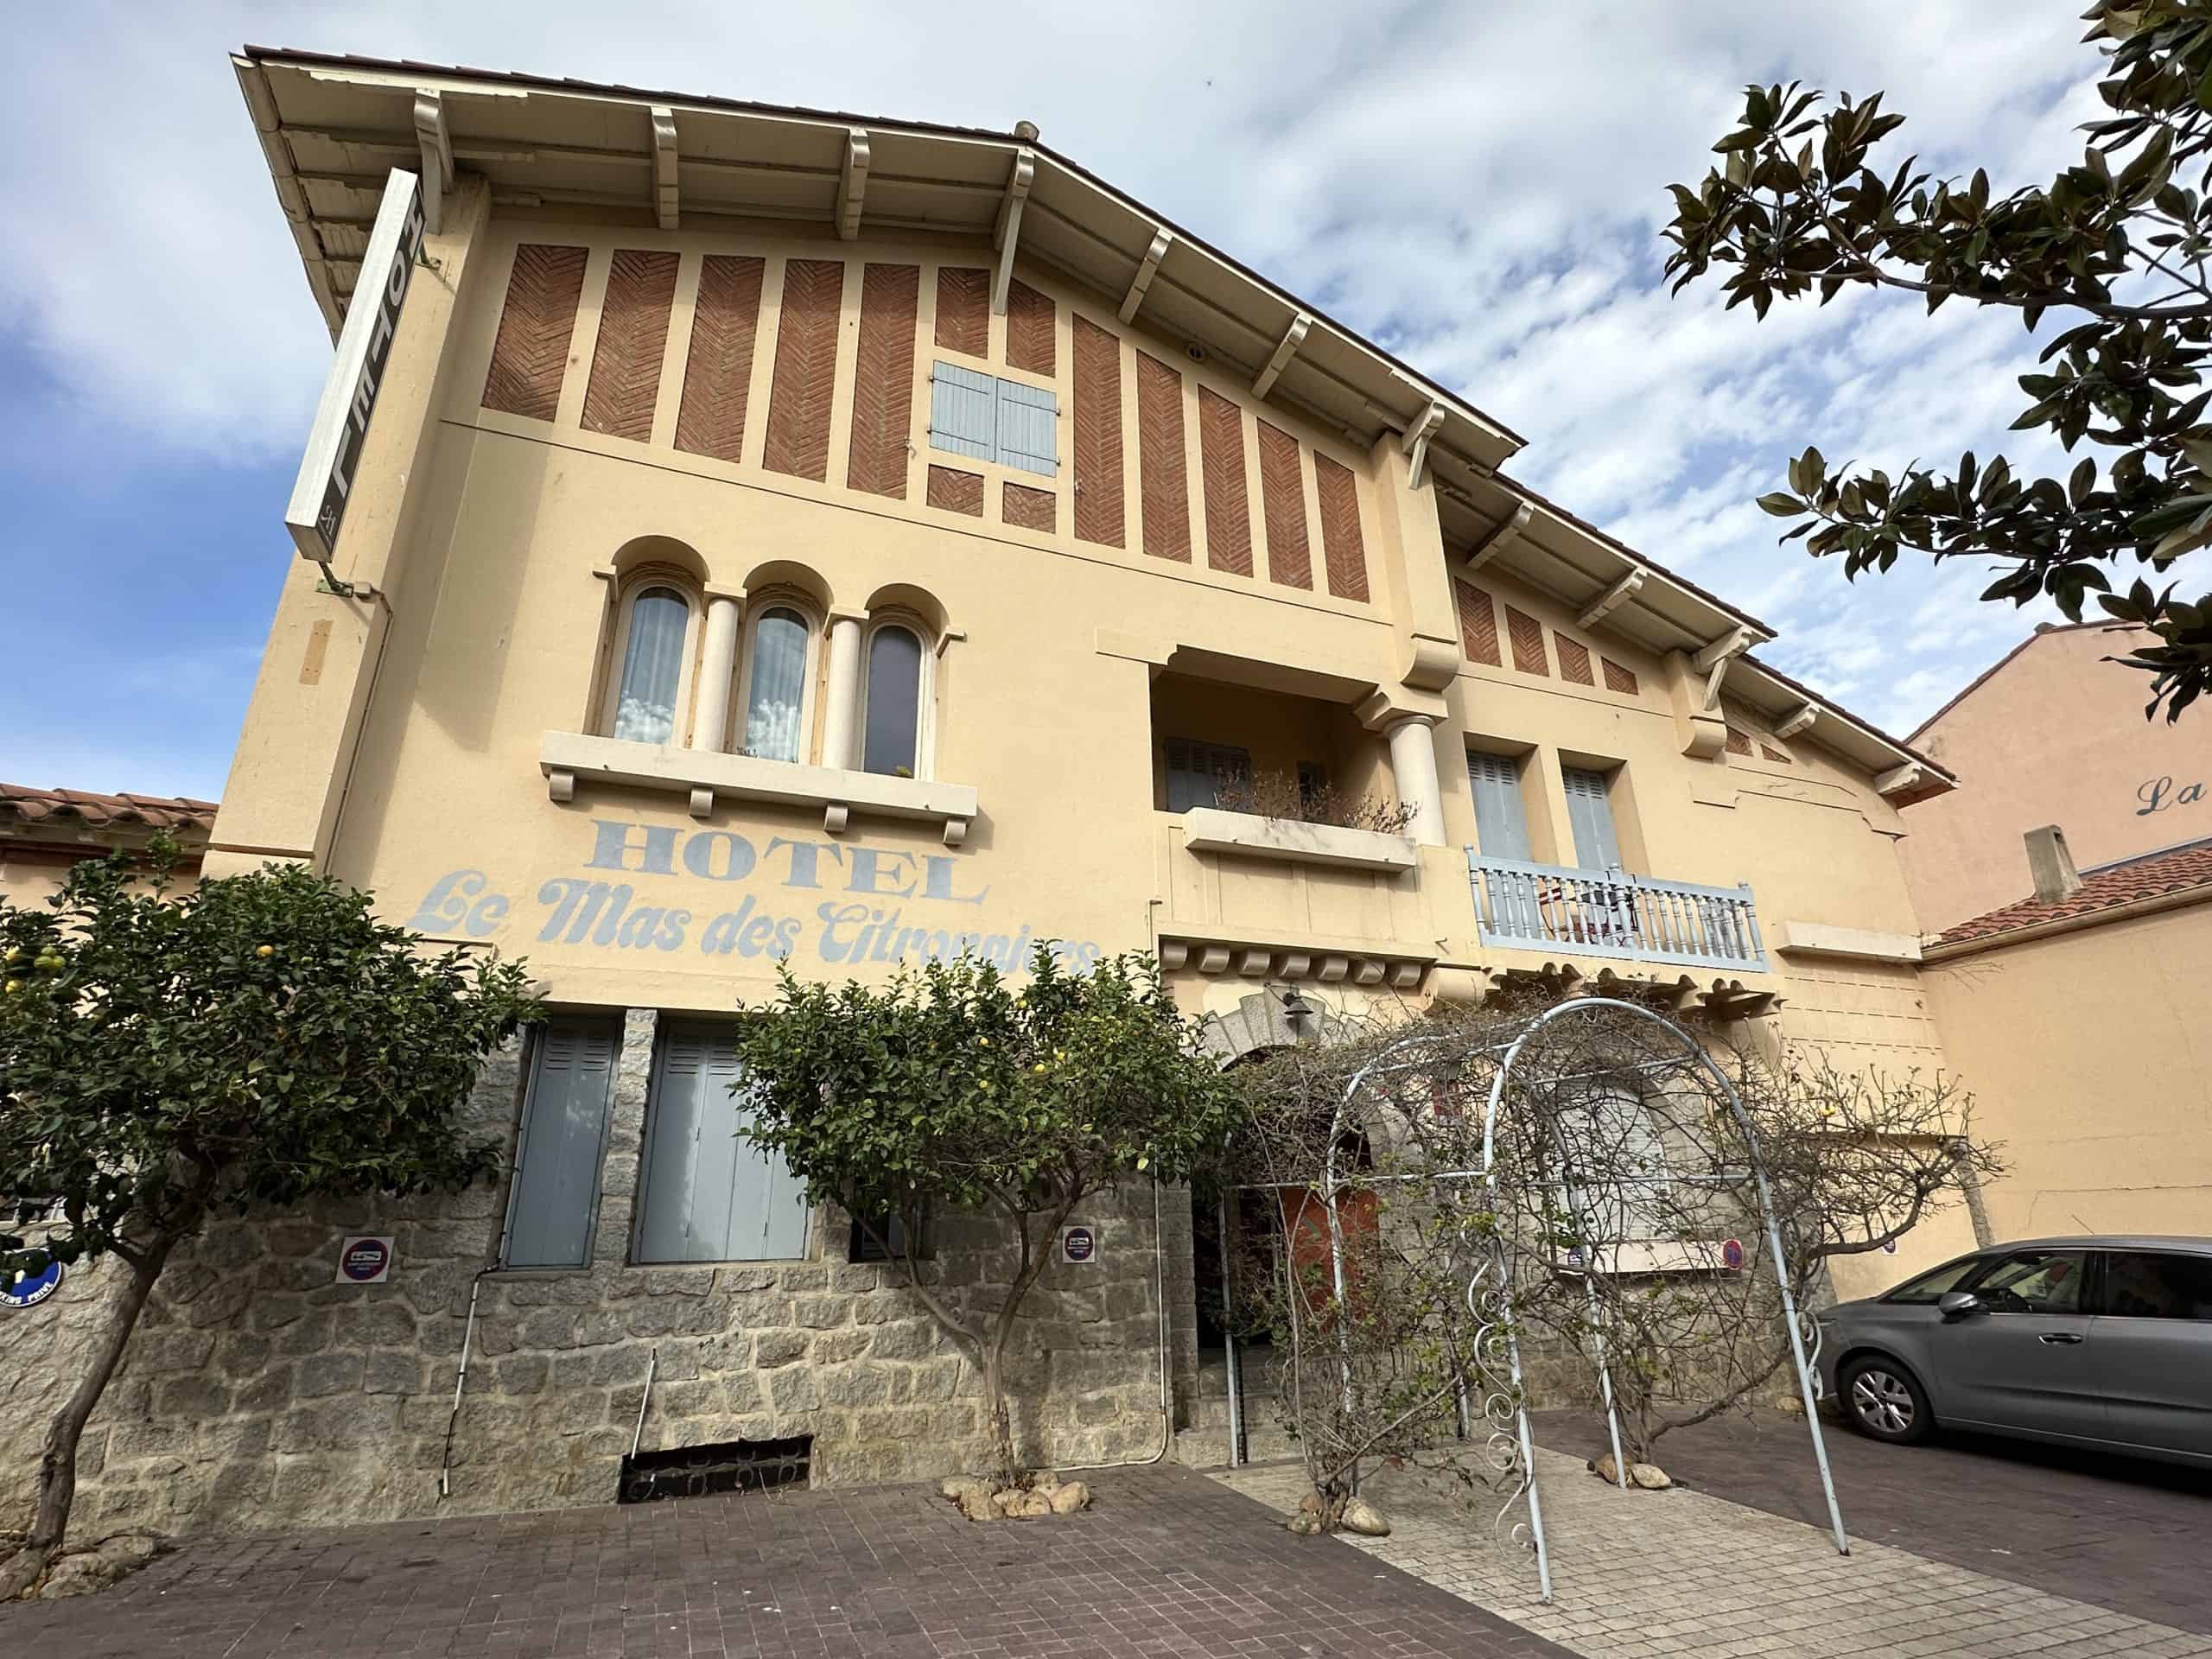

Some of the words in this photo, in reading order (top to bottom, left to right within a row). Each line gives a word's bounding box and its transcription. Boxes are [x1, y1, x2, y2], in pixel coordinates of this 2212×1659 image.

[332, 190, 424, 499] HOTEL
[2136, 776, 2207, 816] La
[582, 819, 991, 906] HOTEL
[406, 869, 509, 937] Le
[537, 877, 692, 951] Mas
[701, 894, 803, 959] des
